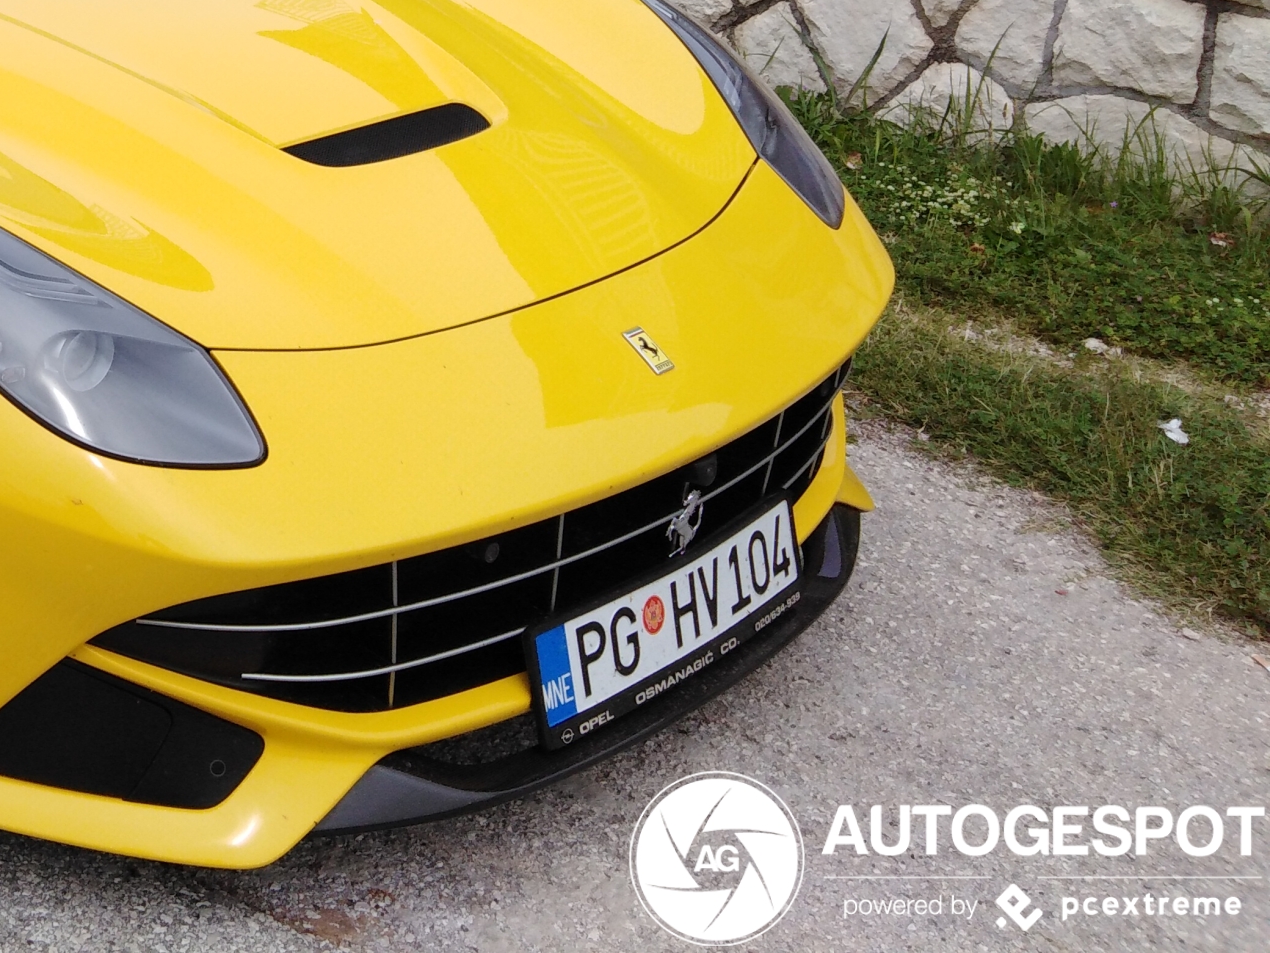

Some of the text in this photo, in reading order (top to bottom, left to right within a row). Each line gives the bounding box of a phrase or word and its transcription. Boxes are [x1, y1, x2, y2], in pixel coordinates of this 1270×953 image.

[542, 672, 574, 713] MNE
[575, 606, 641, 699] PG
[579, 710, 615, 735] OPEL
[720, 637, 740, 655] CO.
